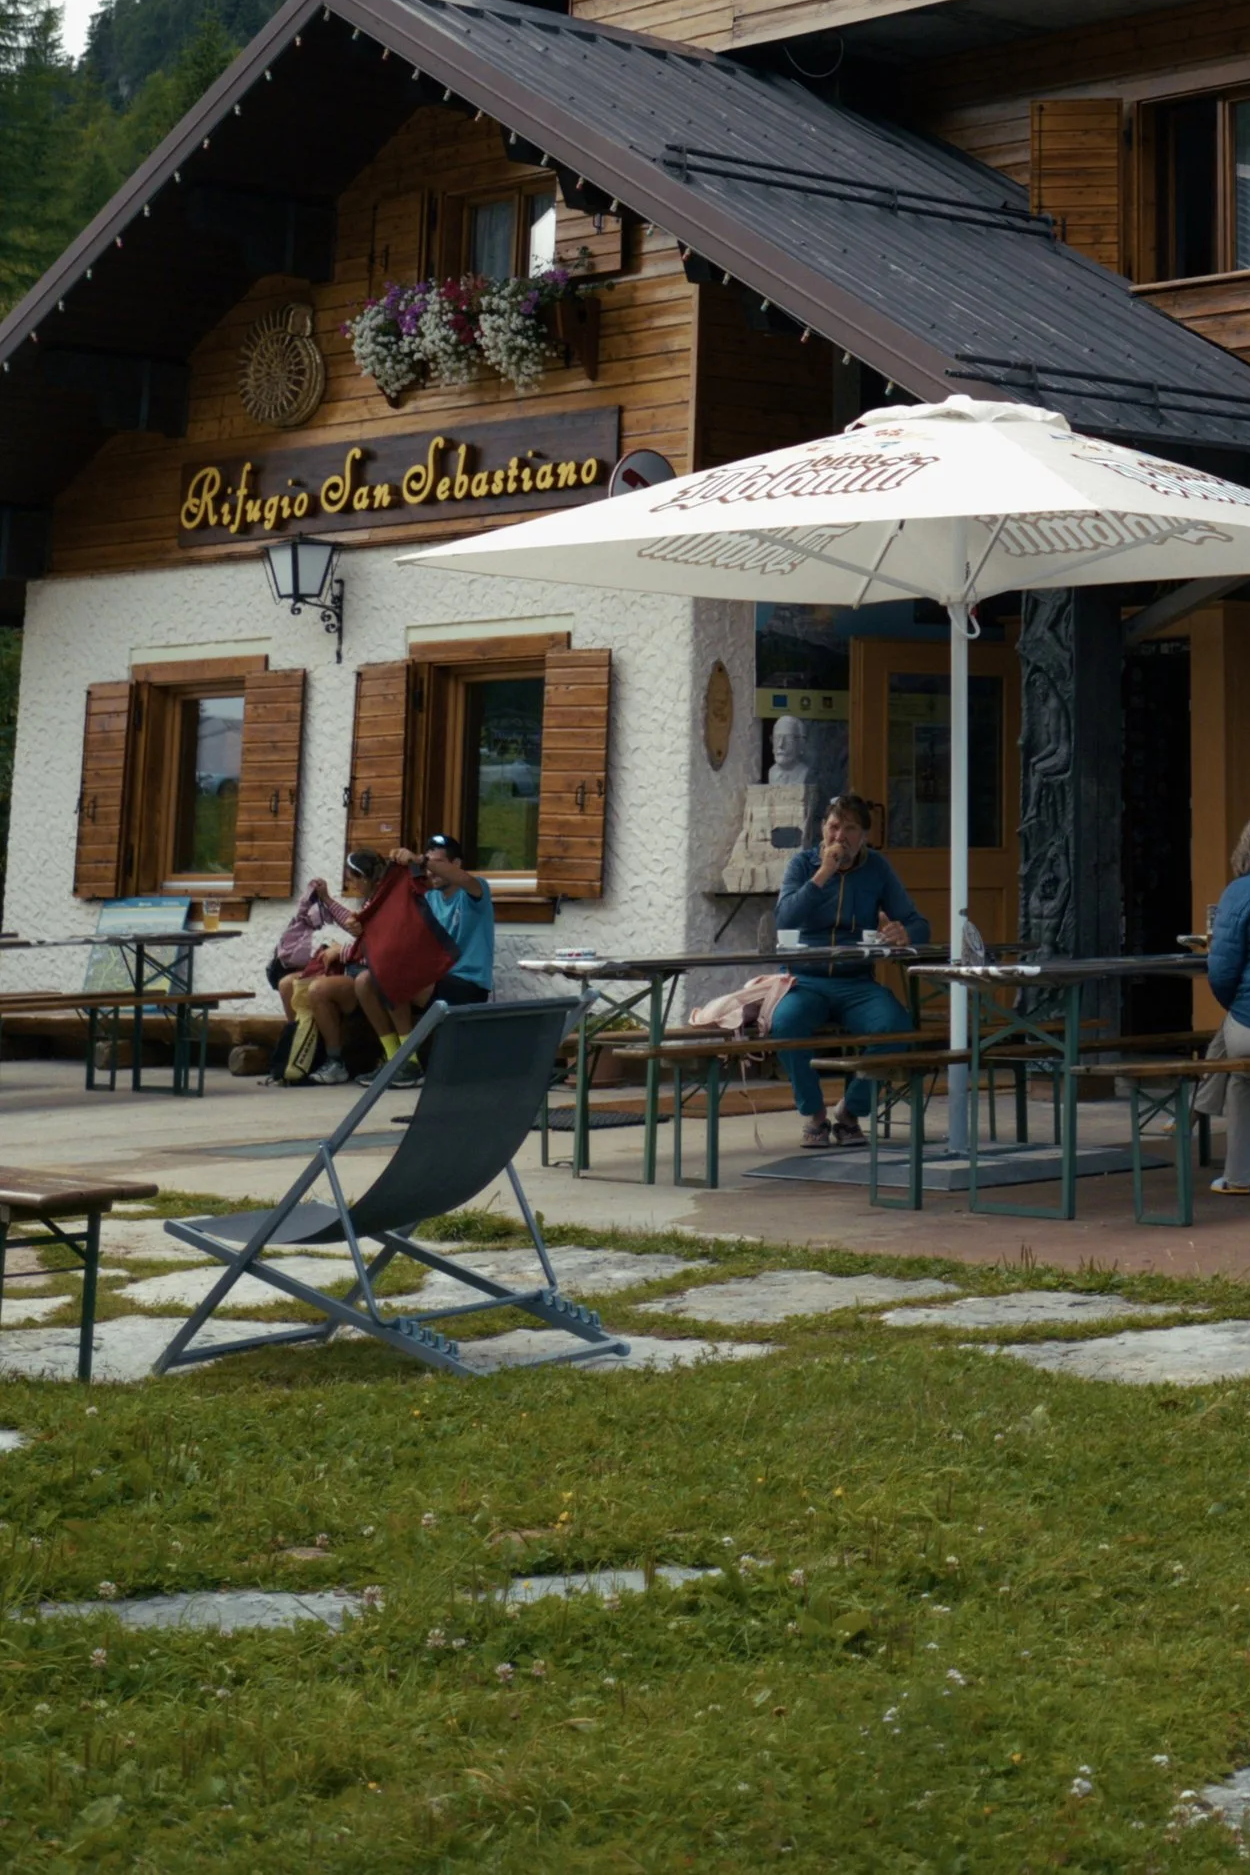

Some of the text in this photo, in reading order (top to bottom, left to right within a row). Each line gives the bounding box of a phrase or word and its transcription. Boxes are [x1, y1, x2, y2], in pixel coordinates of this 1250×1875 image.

[180, 436, 598, 534] Rifugio San Sebastiano
[810, 451, 884, 468] birra
